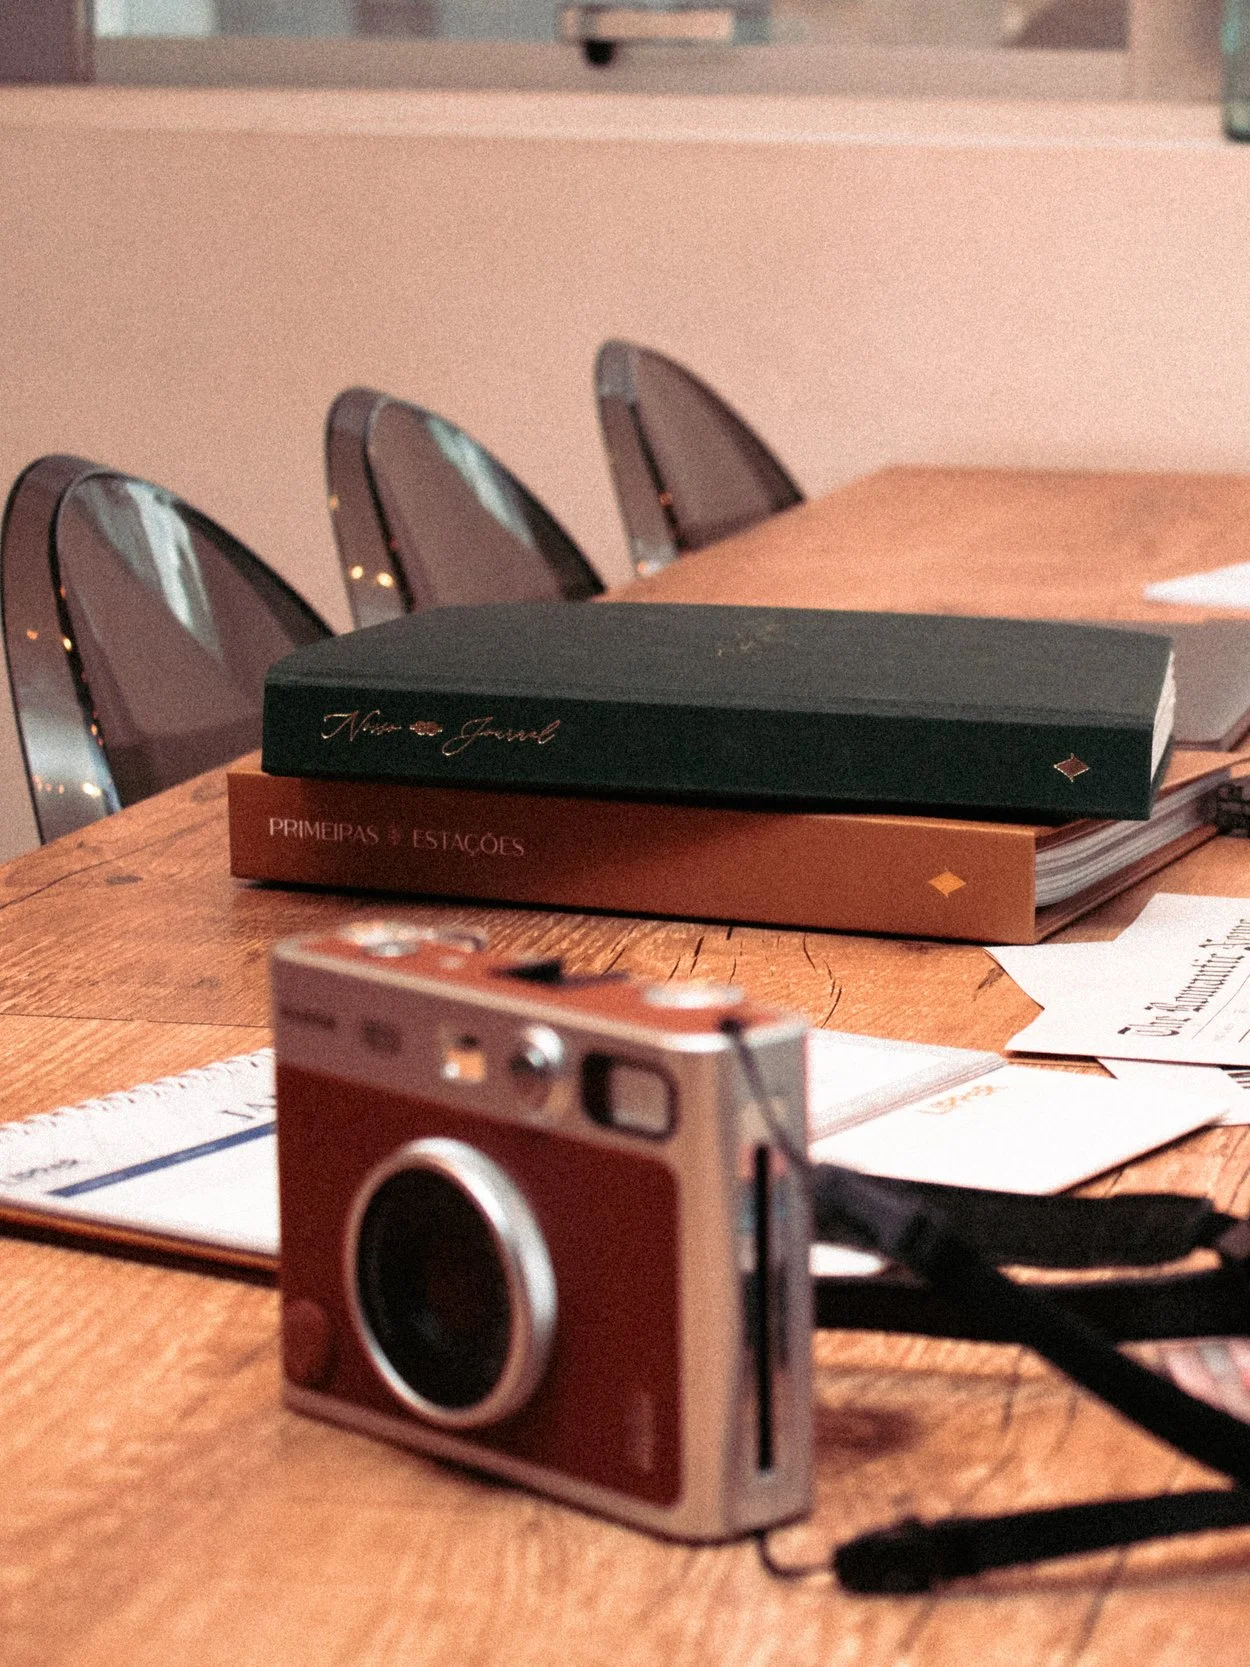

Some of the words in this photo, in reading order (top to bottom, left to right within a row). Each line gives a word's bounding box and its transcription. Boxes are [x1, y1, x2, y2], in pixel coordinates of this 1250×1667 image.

[268, 817, 379, 845] PRIMEIRAS
[412, 828, 525, 857] ESTAÇÕES
[1144, 953, 1245, 1012] Romantic
[1117, 1015, 1191, 1037] The
